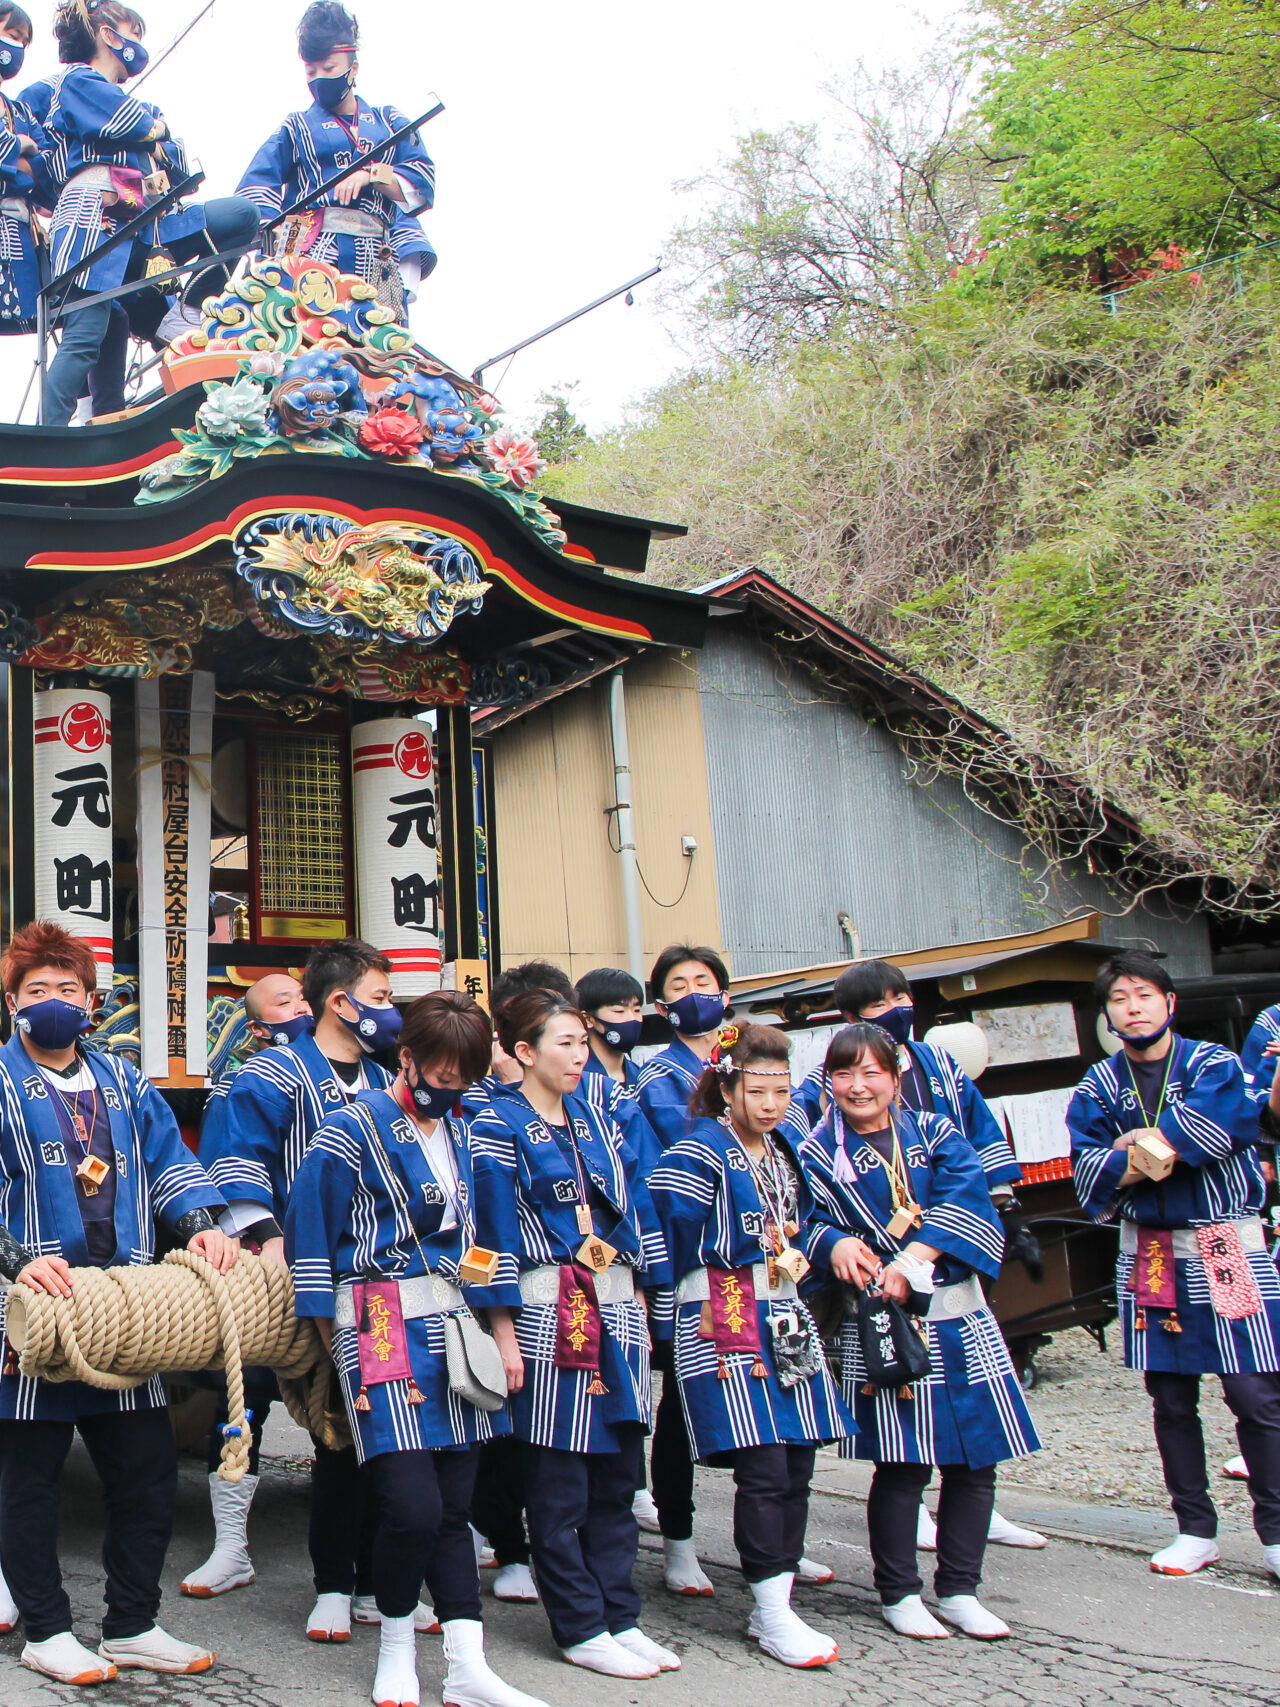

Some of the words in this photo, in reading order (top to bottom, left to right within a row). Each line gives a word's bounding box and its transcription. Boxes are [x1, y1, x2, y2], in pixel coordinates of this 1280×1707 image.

[51, 762, 112, 923] 元町
[386, 787, 439, 938] 元町
[464, 974, 484, 1000] 年
[319, 1077, 342, 1104] 元
[852, 1146, 881, 1174] 元
[906, 1144, 929, 1169] 元
[366, 1294, 396, 1361] 元昇會
[566, 1288, 590, 1352] 元昇會
[720, 1275, 748, 1334] 元昇會
